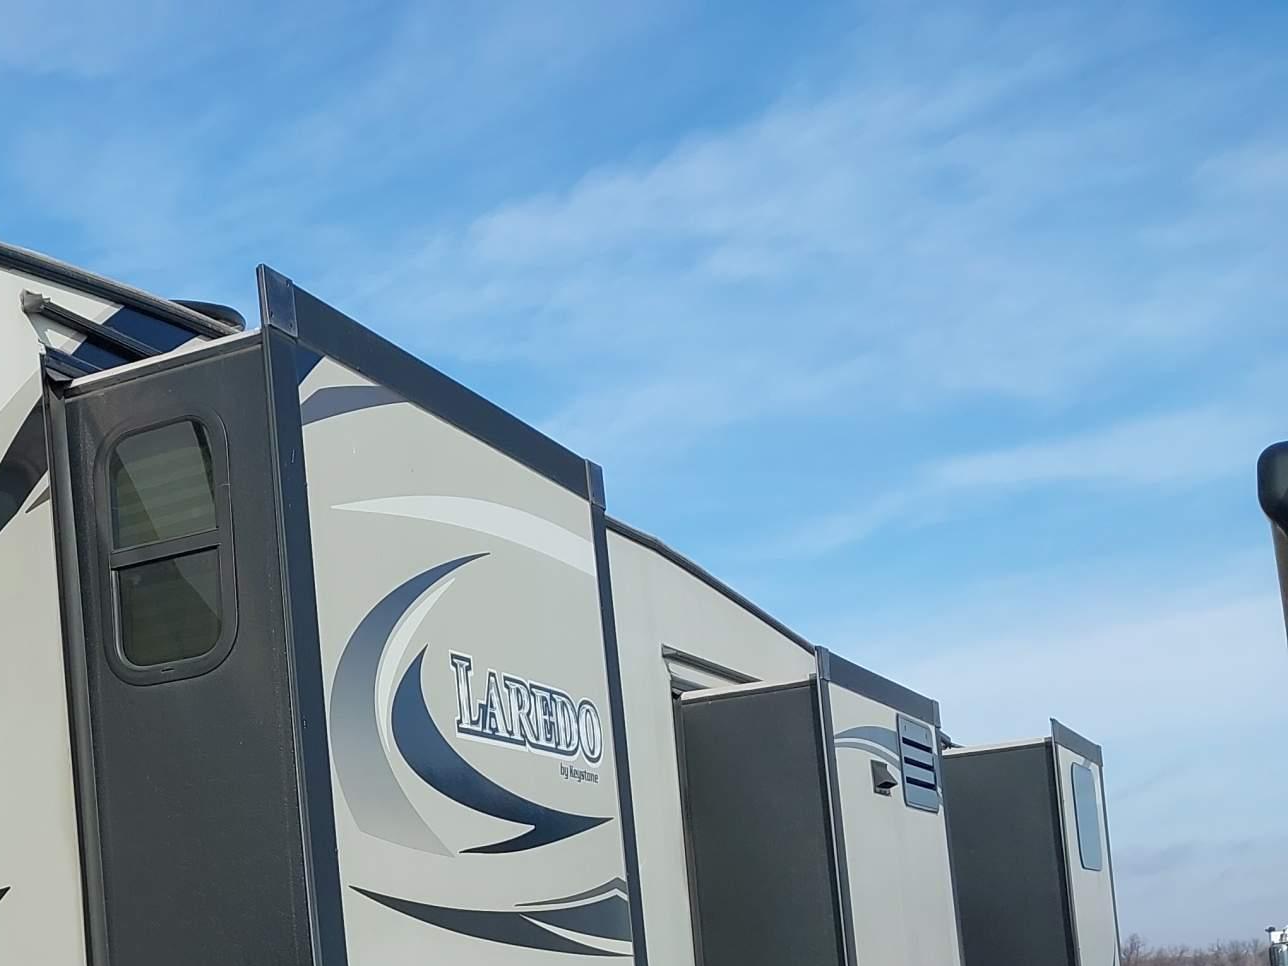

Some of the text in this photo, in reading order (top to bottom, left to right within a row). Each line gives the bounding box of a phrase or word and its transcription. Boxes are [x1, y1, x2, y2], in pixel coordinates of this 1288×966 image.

[449, 649, 604, 767] LAREDO
[560, 761, 599, 784] by Keystone
